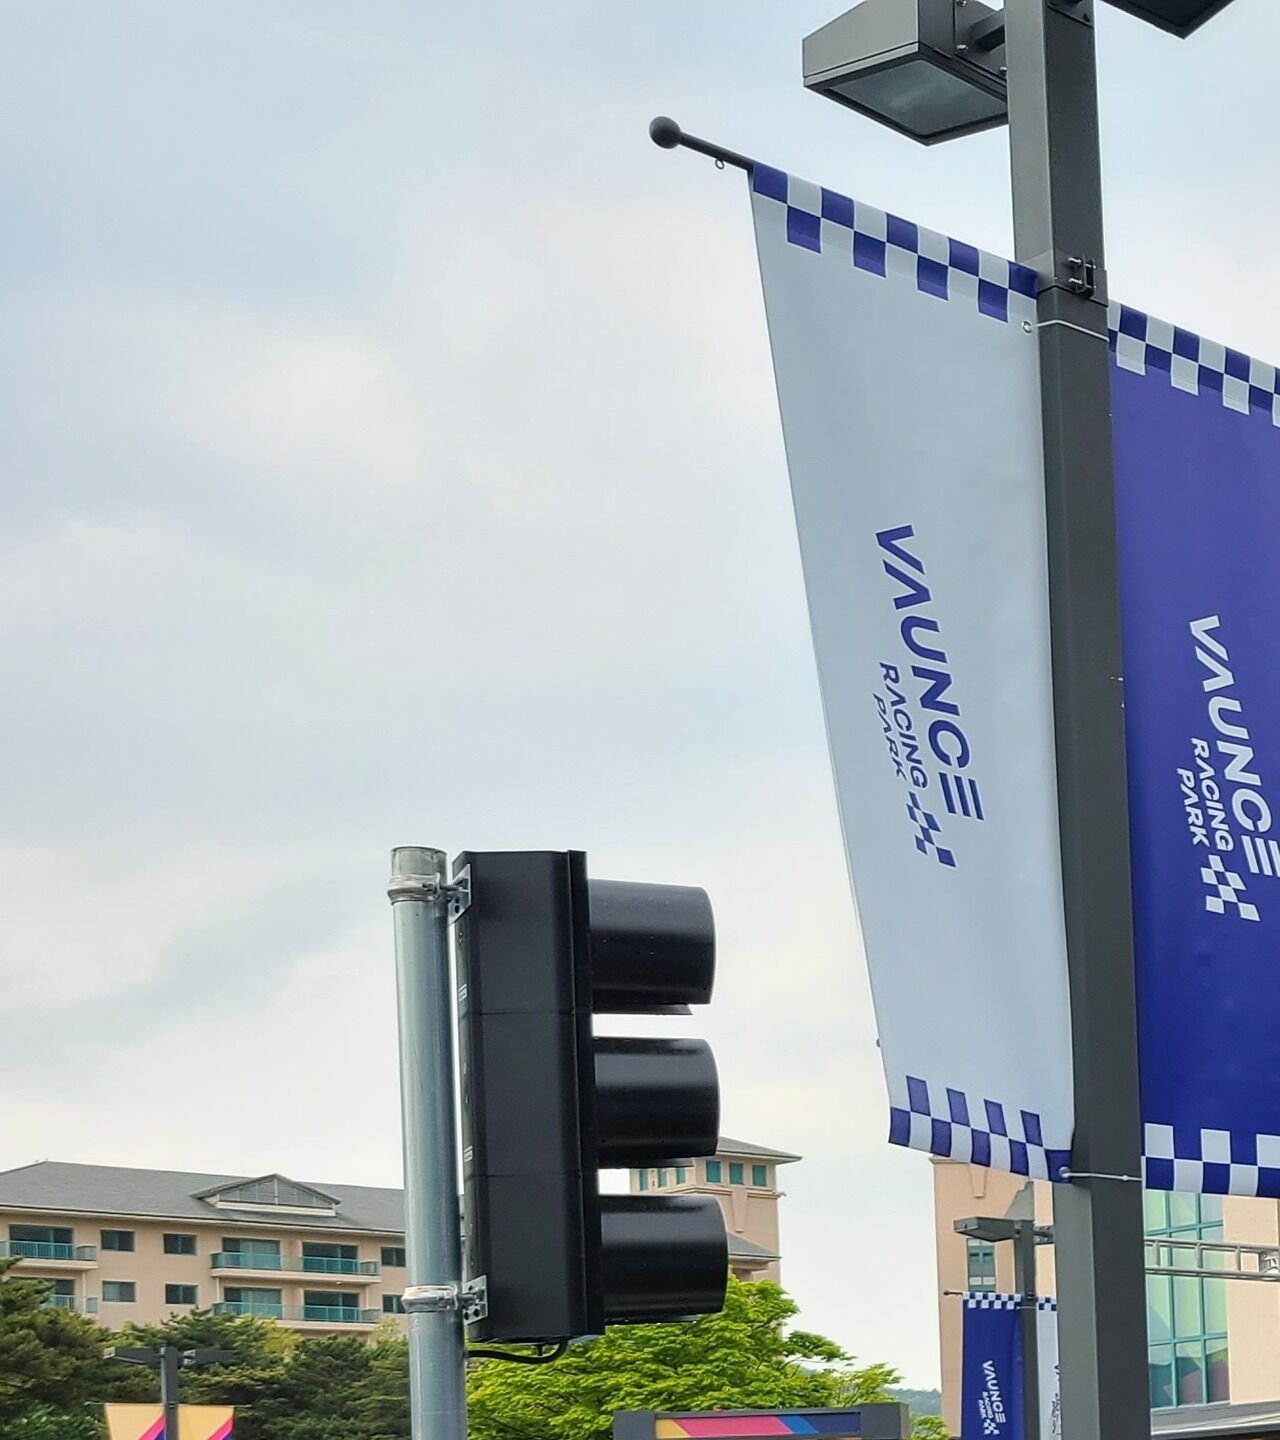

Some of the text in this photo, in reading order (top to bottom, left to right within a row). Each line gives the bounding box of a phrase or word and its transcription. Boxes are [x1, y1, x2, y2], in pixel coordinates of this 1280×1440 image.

[875, 524, 984, 822] VAUNCE
[873, 693, 905, 778] PARK
[879, 661, 928, 789] RACING
[1177, 768, 1208, 846] PARK
[1190, 737, 1233, 852] RACING
[982, 1360, 1006, 1423] VAUNCE
